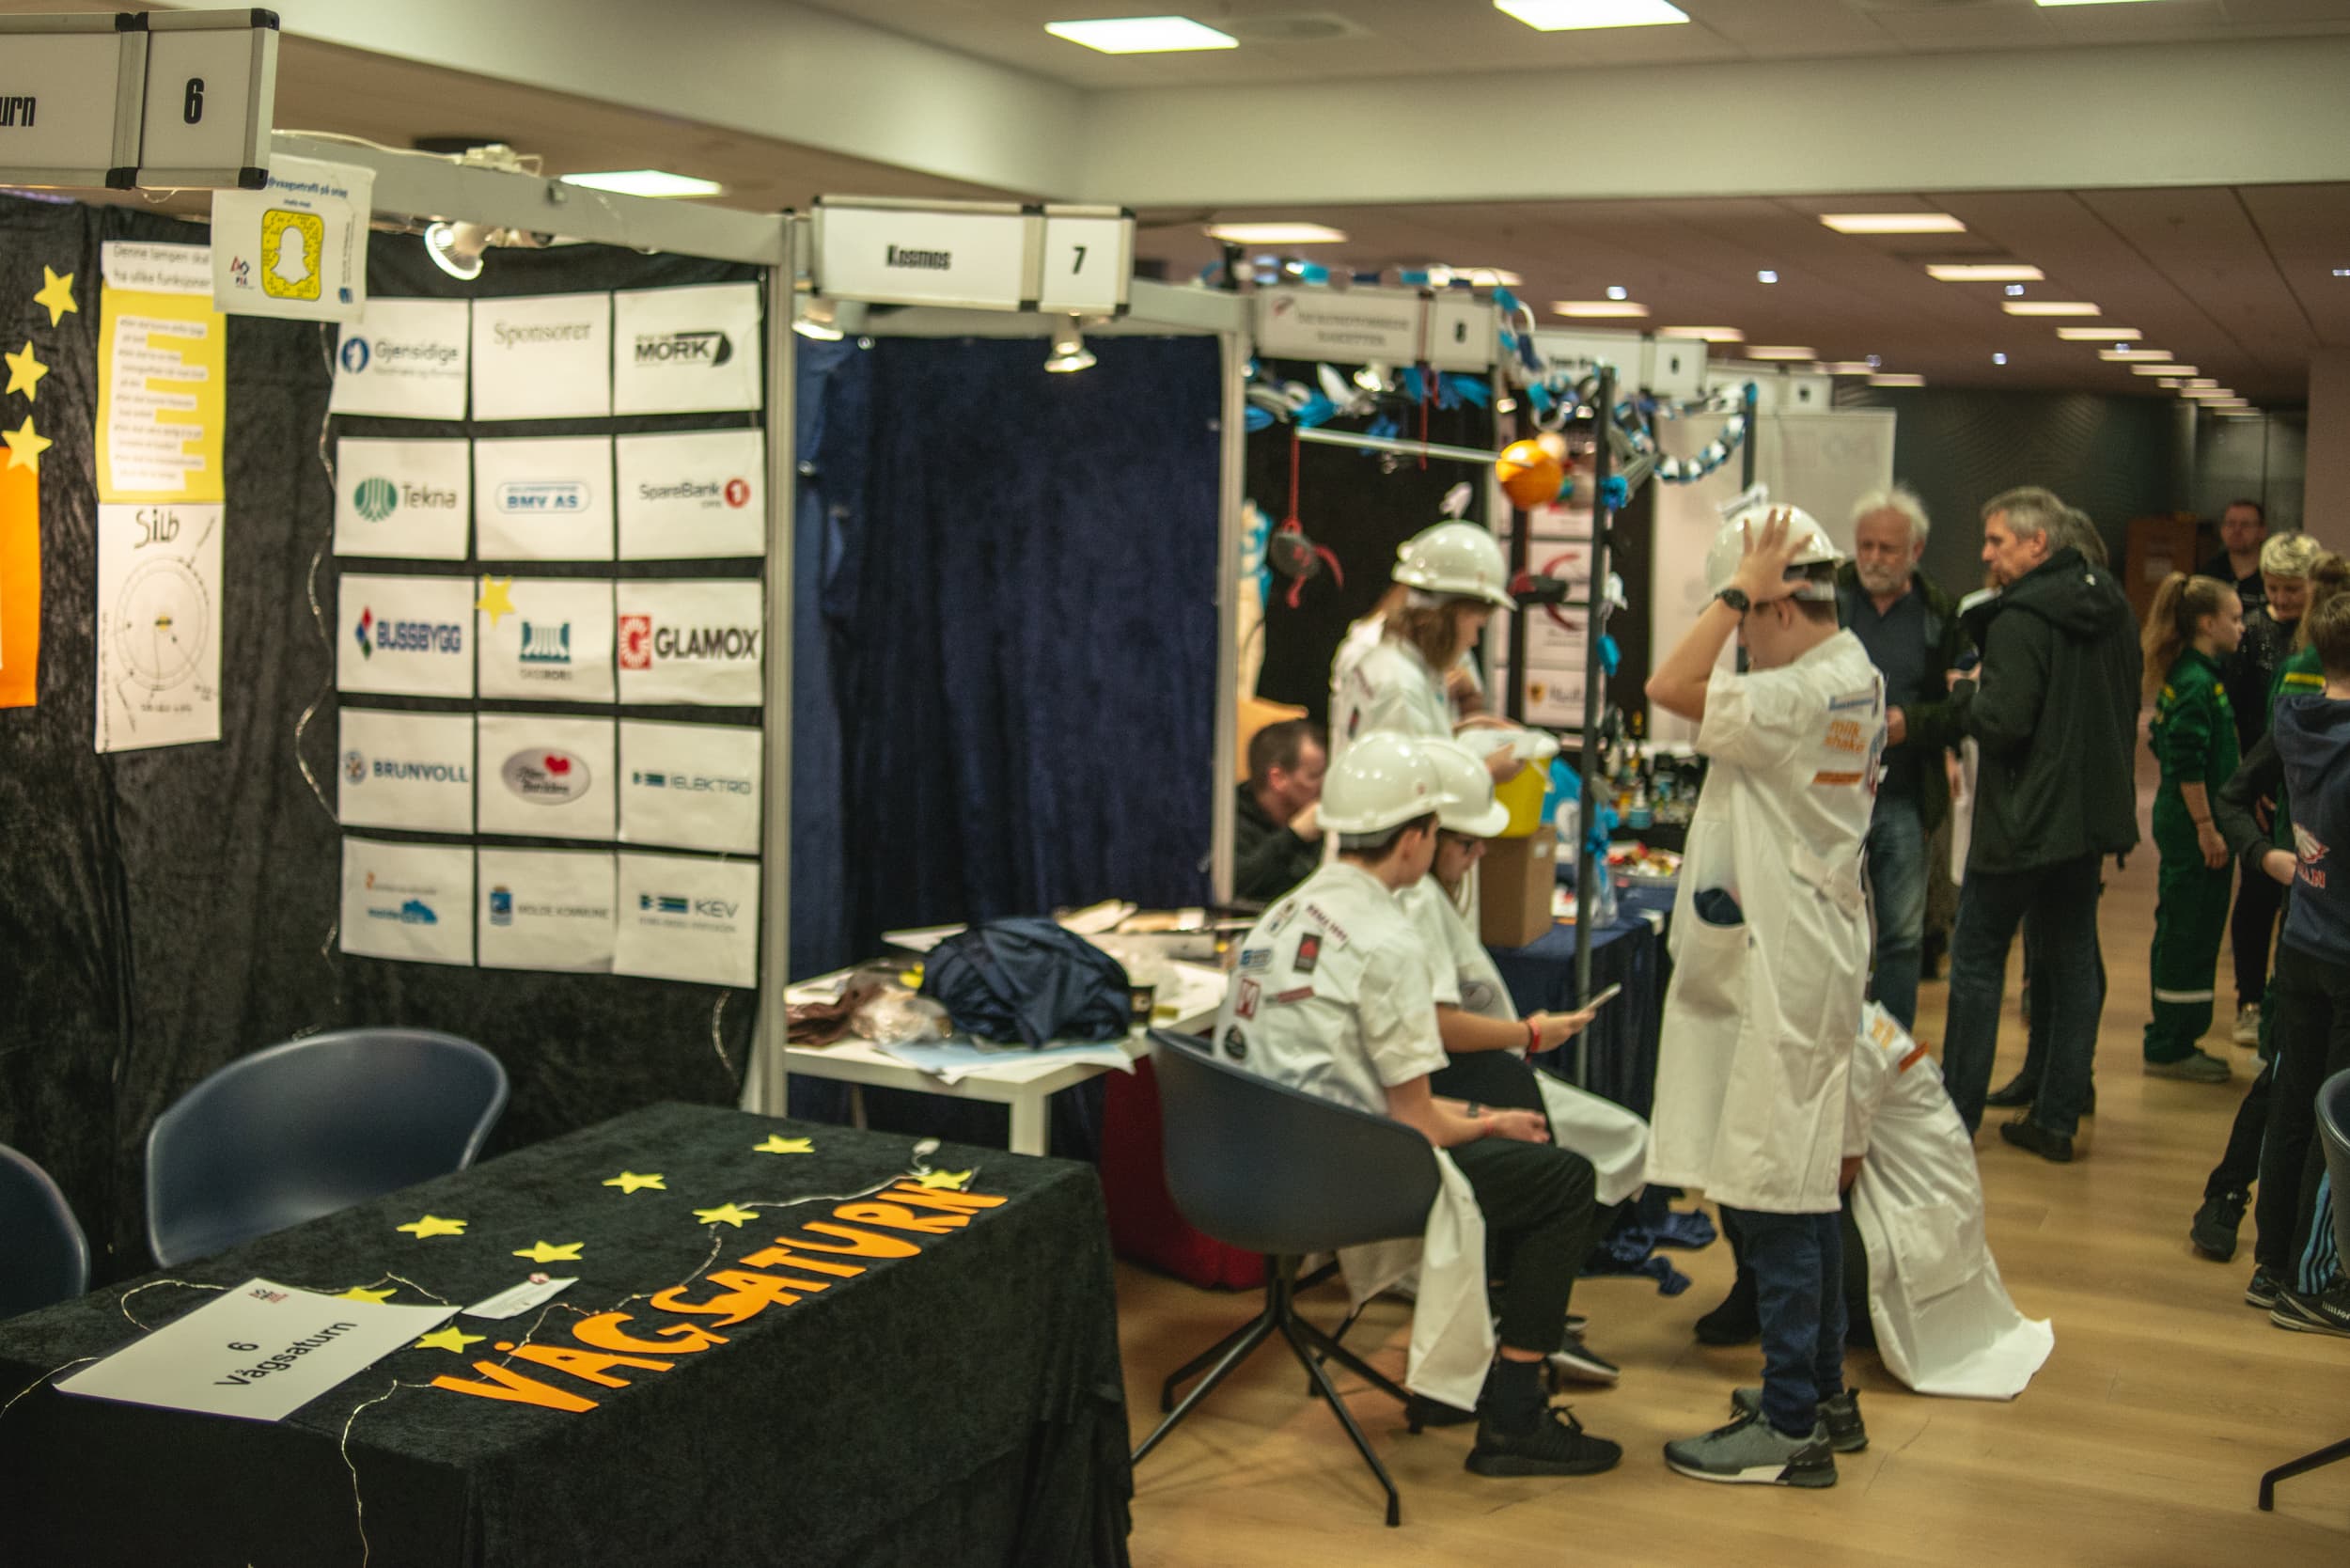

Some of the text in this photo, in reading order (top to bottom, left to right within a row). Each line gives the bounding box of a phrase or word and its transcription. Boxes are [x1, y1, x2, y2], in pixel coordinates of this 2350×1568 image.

[183, 77, 205, 124] 6
[885, 244, 952, 271] Kosmos
[1072, 246, 1087, 274] 7
[494, 321, 591, 349] Sponsorer
[376, 339, 458, 365] Gjensidige
[634, 339, 711, 363] MORK
[403, 484, 457, 509] Tekna
[507, 494, 579, 509] BMV AS
[638, 480, 721, 502] SpareBank
[654, 627, 759, 659] GLAMOX
[373, 760, 469, 782] BRUNVOLL
[695, 900, 739, 918] KEV
[431, 1182, 1009, 1413] VÅGSATURN
[214, 1320, 357, 1387] Vågsaturn
[227, 1341, 259, 1352] 6
